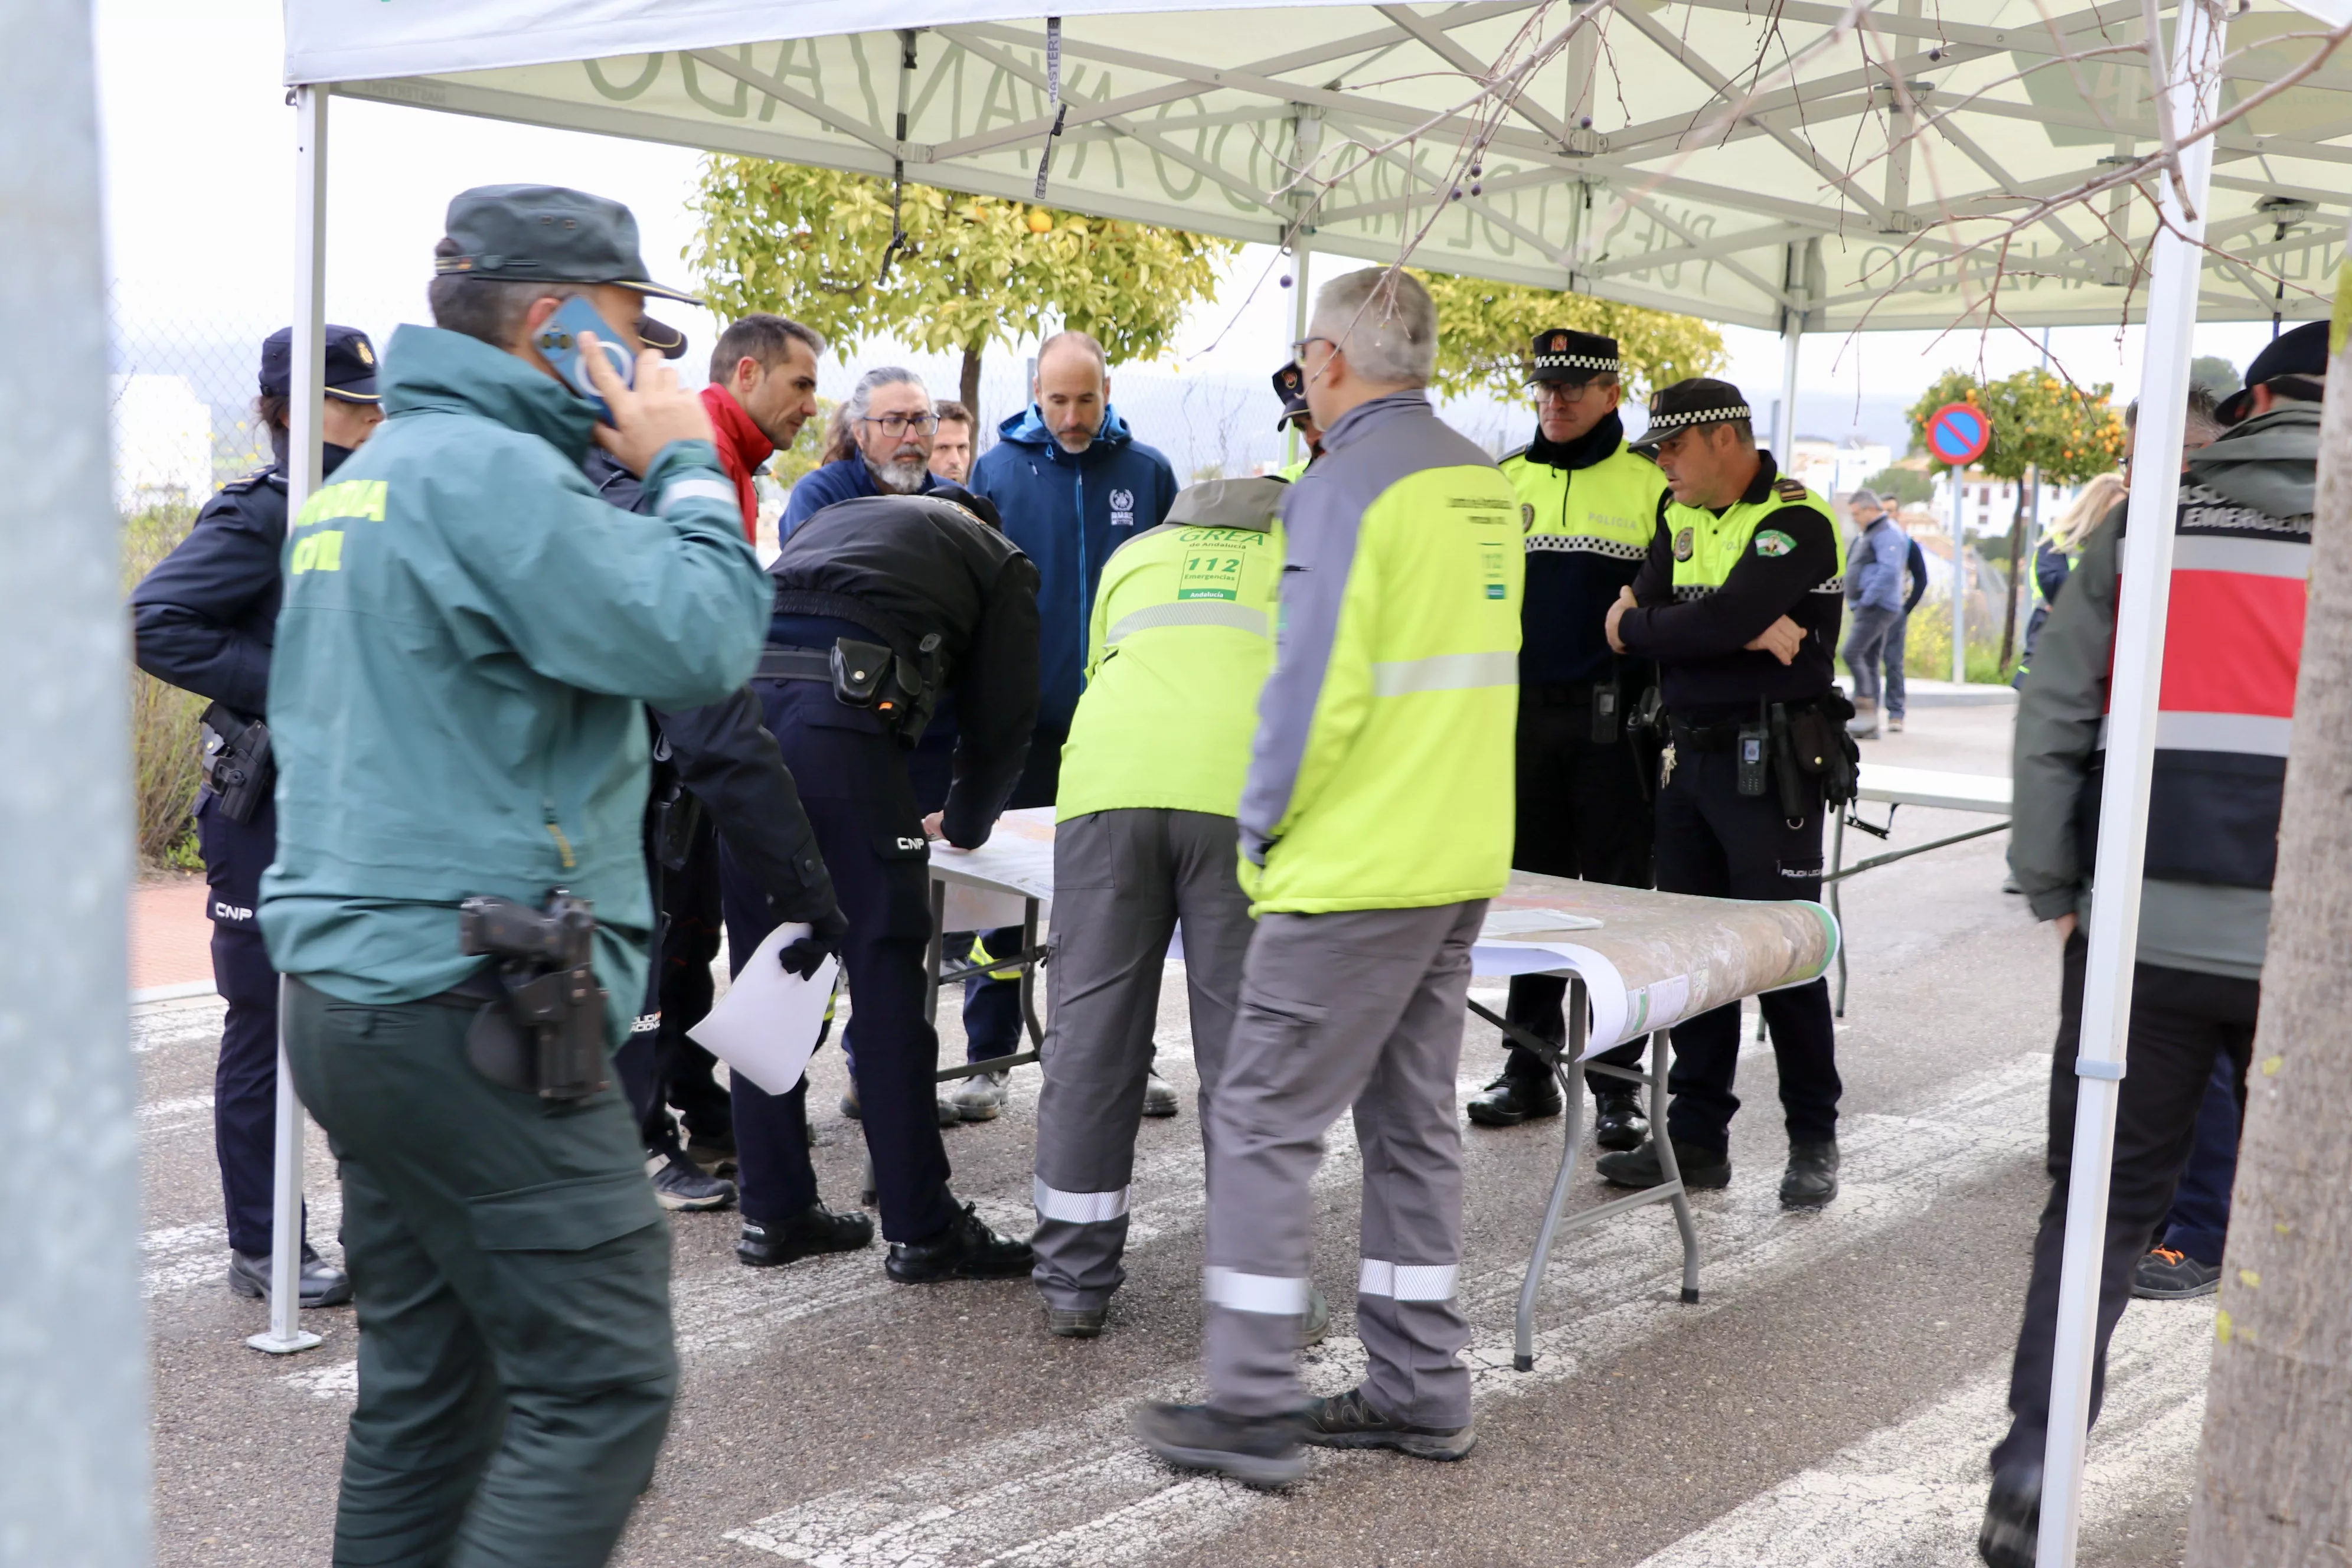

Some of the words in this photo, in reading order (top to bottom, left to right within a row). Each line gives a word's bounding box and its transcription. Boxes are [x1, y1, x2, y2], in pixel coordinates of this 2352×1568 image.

[1180, 529, 1265, 547] GREA
[1202, 541, 1247, 550] Andalucía
[1188, 557, 1240, 573] 112
[897, 837, 925, 850] CNP
[215, 901, 253, 922] CNP
